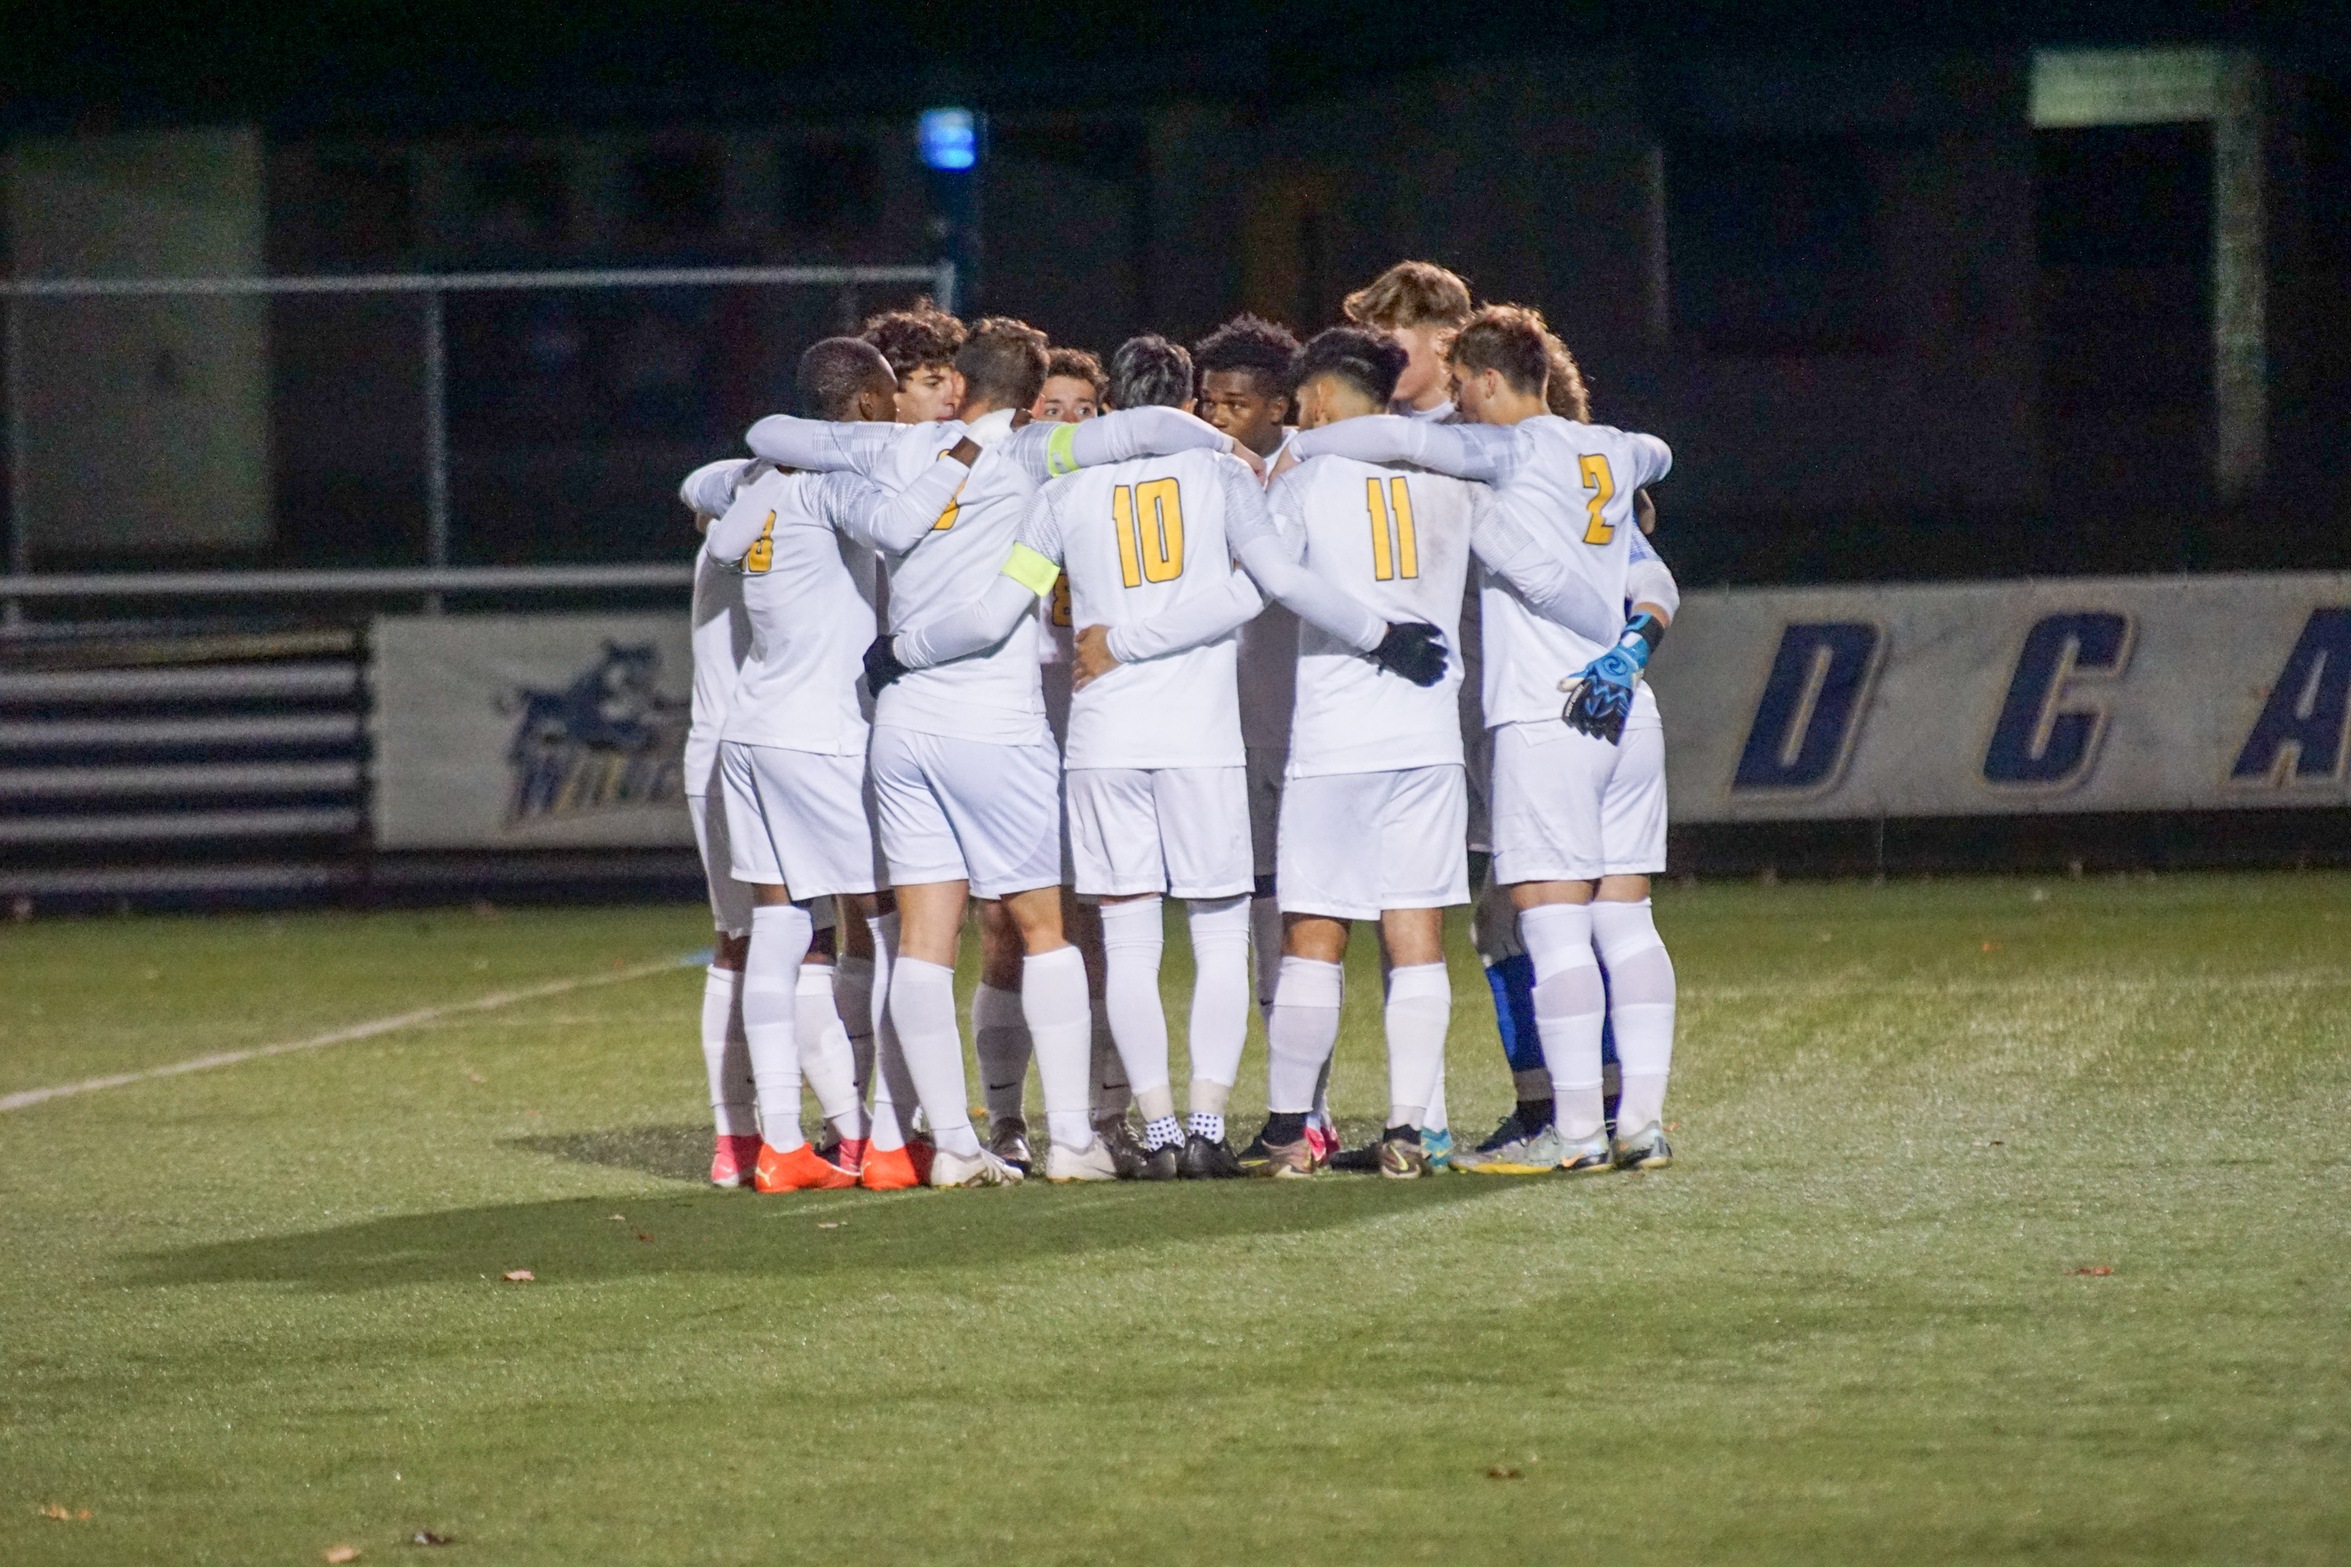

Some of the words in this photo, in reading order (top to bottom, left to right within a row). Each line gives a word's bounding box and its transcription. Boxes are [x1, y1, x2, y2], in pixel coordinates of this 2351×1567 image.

[1112, 477, 1185, 588] 10
[1366, 476, 1419, 582] 11
[1578, 453, 1616, 545] 2
